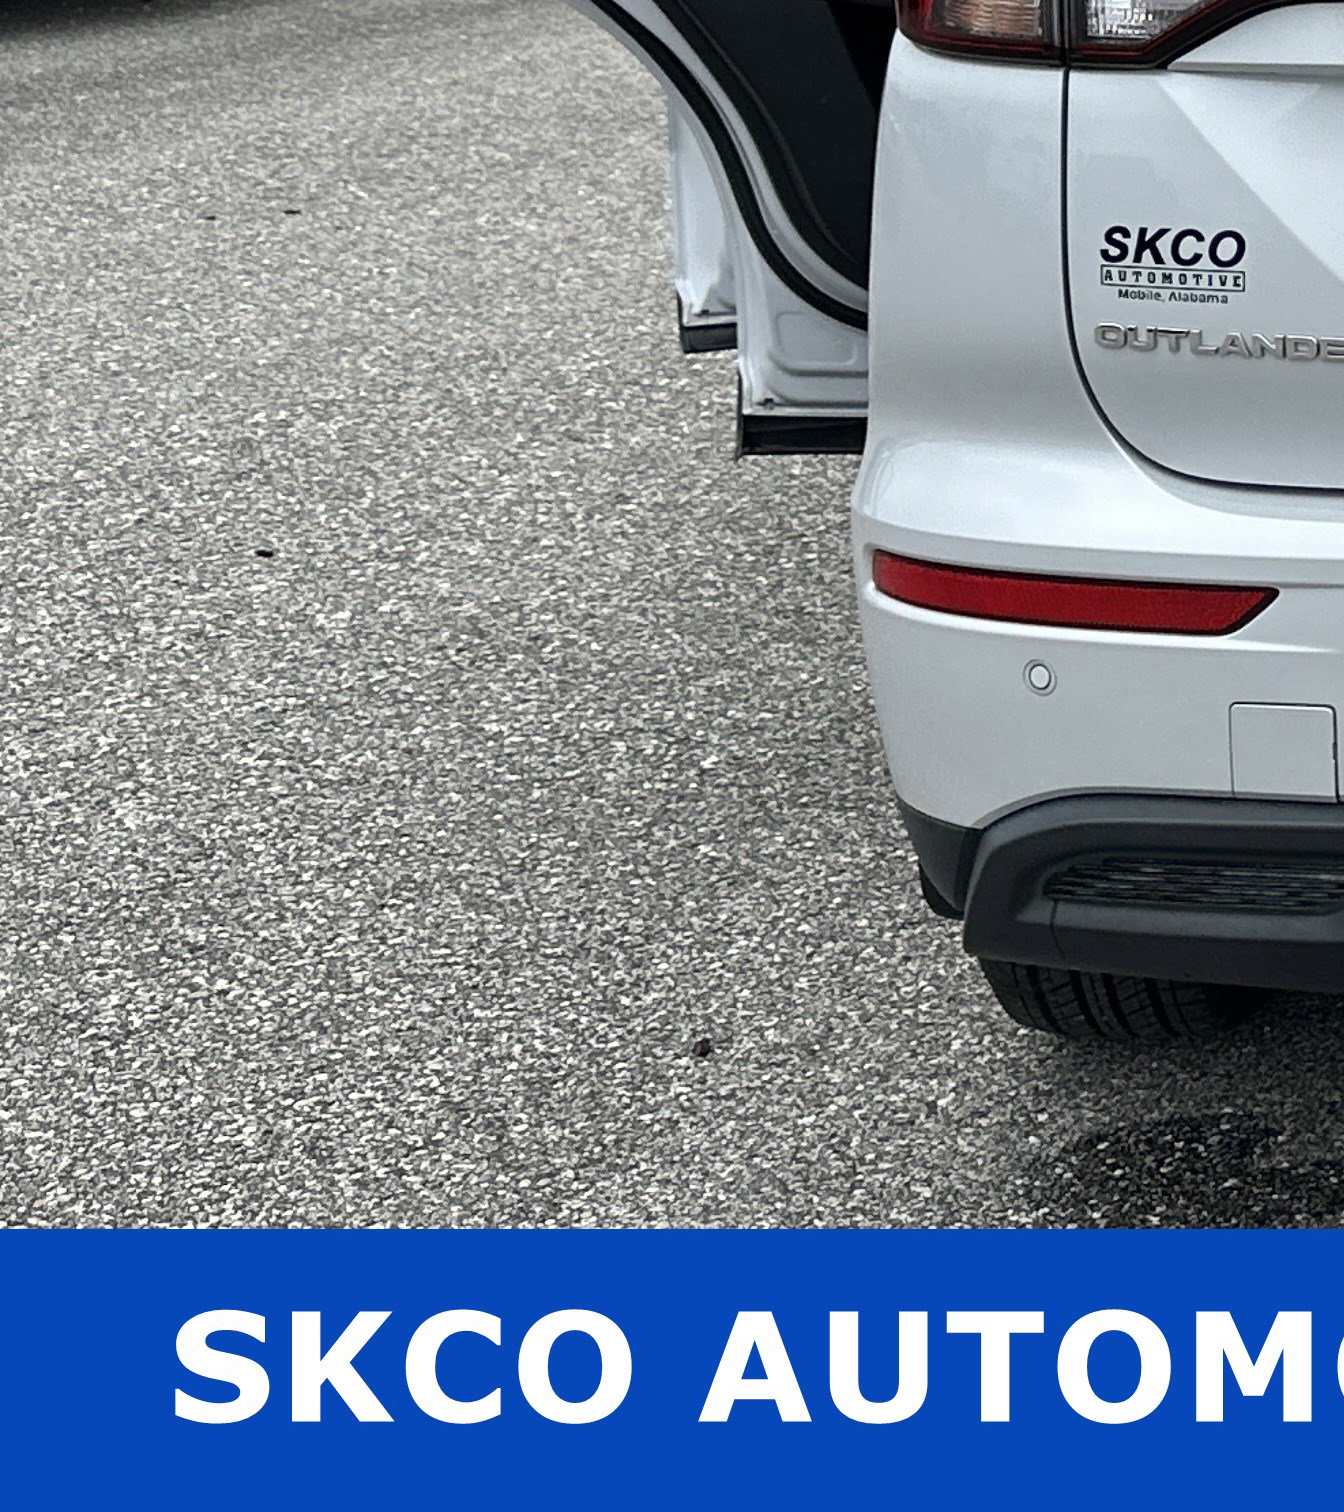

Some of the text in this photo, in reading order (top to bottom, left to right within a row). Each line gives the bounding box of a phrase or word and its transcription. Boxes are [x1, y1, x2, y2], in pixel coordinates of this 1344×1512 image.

[1100, 225, 1246, 267] SKCO
[1104, 269, 1242, 287] AUTOMOTIVE
[1118, 288, 1229, 305] Mobile, Alabama
